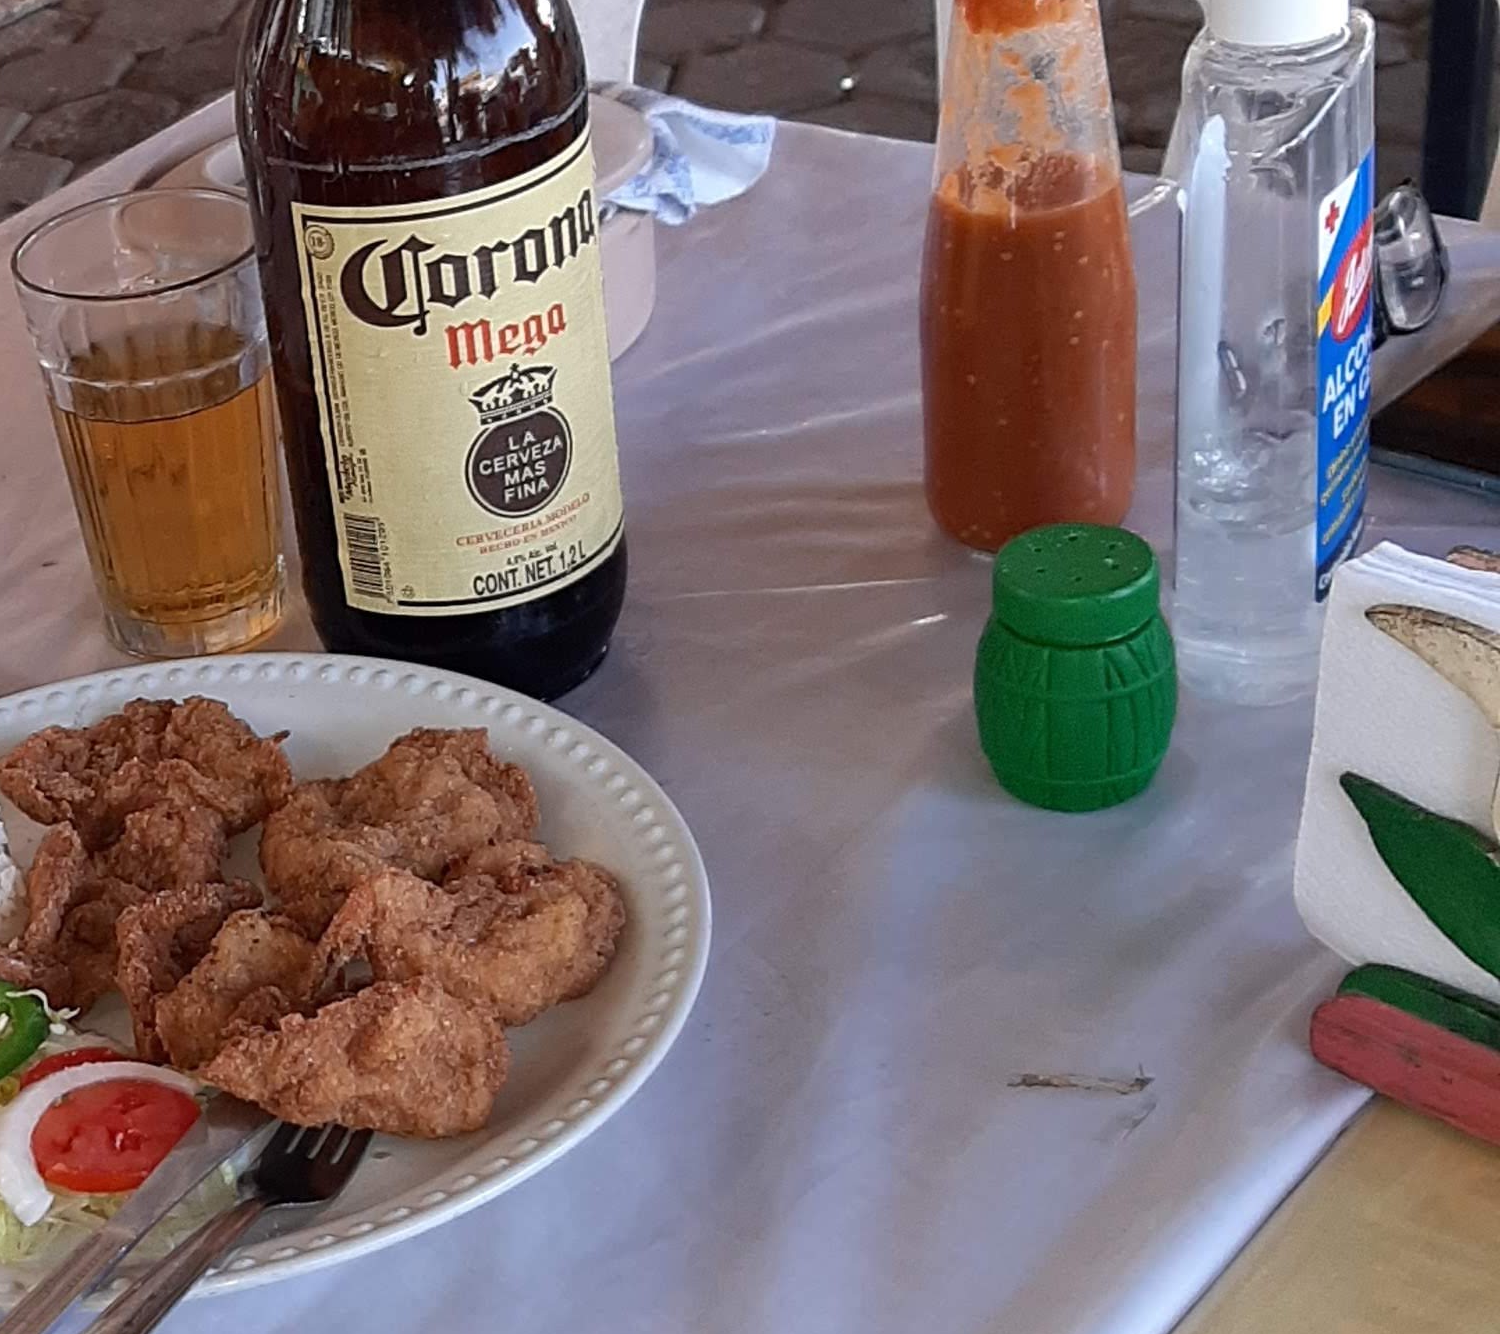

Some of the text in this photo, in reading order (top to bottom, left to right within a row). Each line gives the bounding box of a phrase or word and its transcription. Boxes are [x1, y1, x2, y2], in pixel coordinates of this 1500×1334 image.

[340, 189, 597, 336] Corona
[445, 303, 567, 370] Mega
[1333, 383, 1357, 440] EN
[479, 435, 564, 475] CERVEZA
[507, 431, 537, 451] LA
[504, 460, 547, 487] MAS
[504, 478, 550, 504] FINA
[545, 492, 591, 526] MODELO
[473, 567, 522, 596] CONT.
[525, 556, 557, 584] NET.
